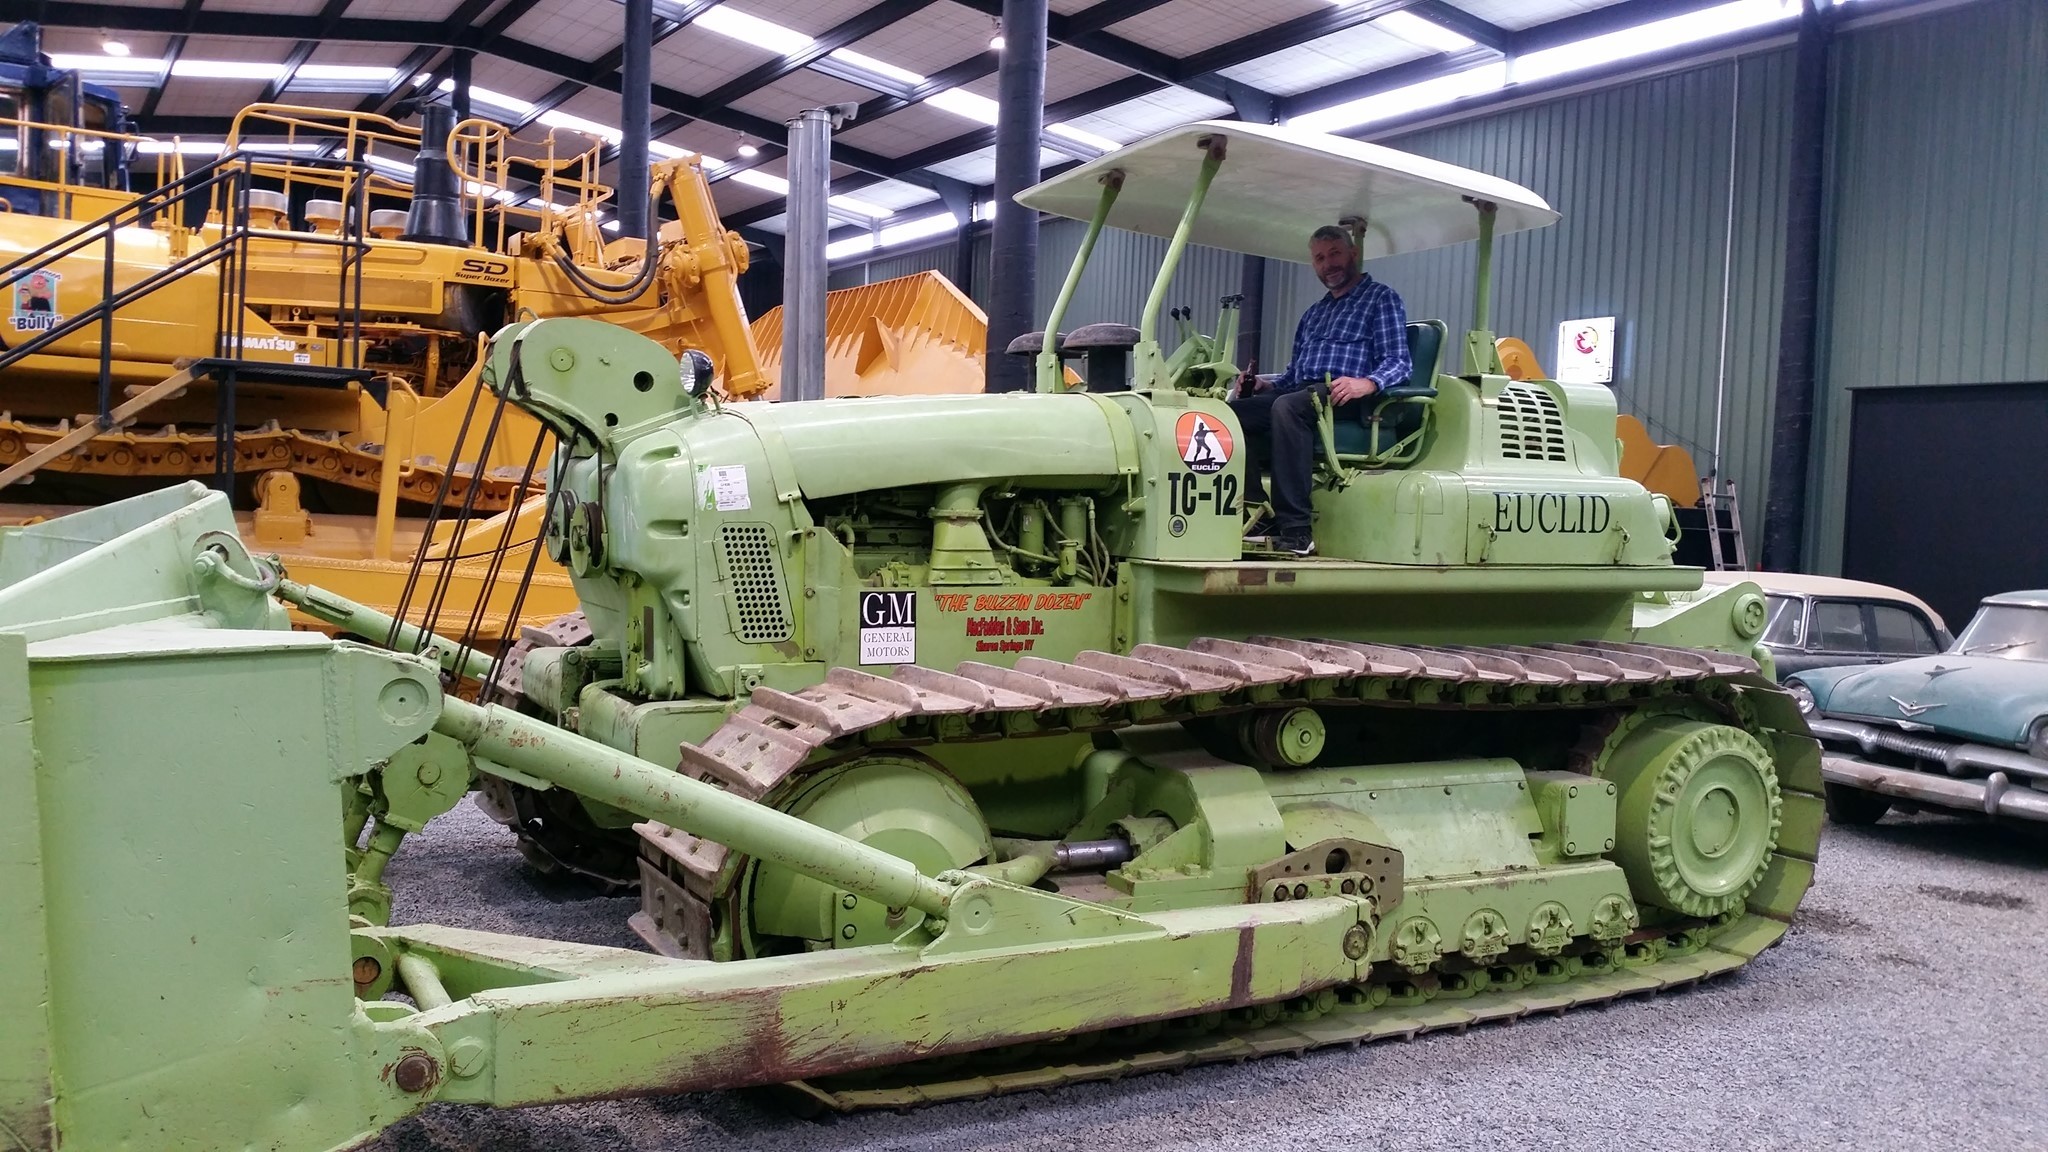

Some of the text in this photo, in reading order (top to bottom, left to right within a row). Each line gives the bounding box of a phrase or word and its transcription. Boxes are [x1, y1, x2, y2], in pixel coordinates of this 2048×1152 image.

[462, 259, 508, 275] SD
[1168, 472, 1237, 516] TC-12
[1493, 492, 1610, 533] EUCLID
[863, 592, 915, 626] GM
[974, 593, 1033, 611] BUZZIN
[864, 632, 912, 643] GENERAL
[867, 647, 909, 657] MOTORS
